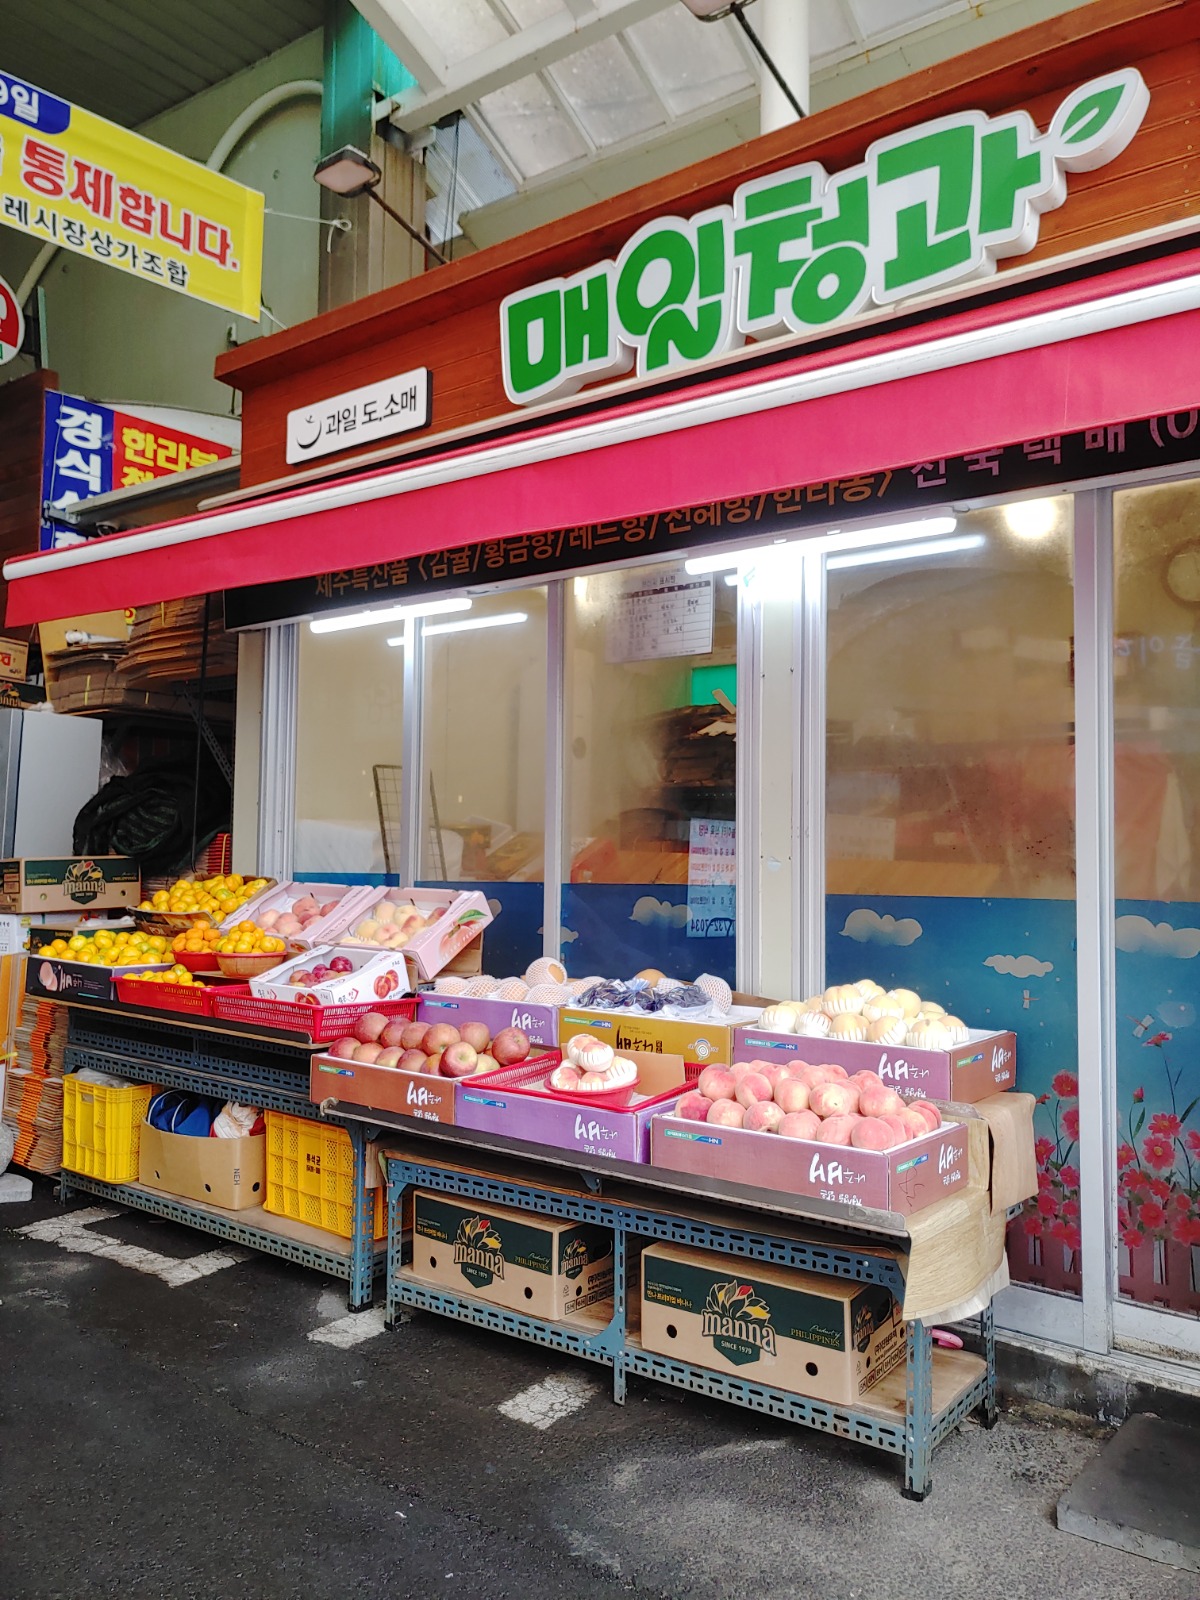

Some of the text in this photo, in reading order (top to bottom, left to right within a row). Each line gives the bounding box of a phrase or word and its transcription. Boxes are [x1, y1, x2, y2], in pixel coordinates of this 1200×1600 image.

[22, 136, 240, 271] 통제합니다.
[506, 124, 1042, 395] 매일청과
[325, 405, 357, 435] 과일
[64, 880, 106, 896] manna
[878, 1052, 930, 1081] 나주배
[406, 1080, 442, 1106] 나주배
[574, 1113, 618, 1142] 나주배
[809, 1152, 866, 1186] 나주배
[454, 1242, 505, 1280] manna
[514, 1255, 549, 1272] PHILIPPINES
[703, 1310, 775, 1355] manna
[721, 1340, 738, 1351] SINCE
[790, 1328, 841, 1347] PHILIPPINES
